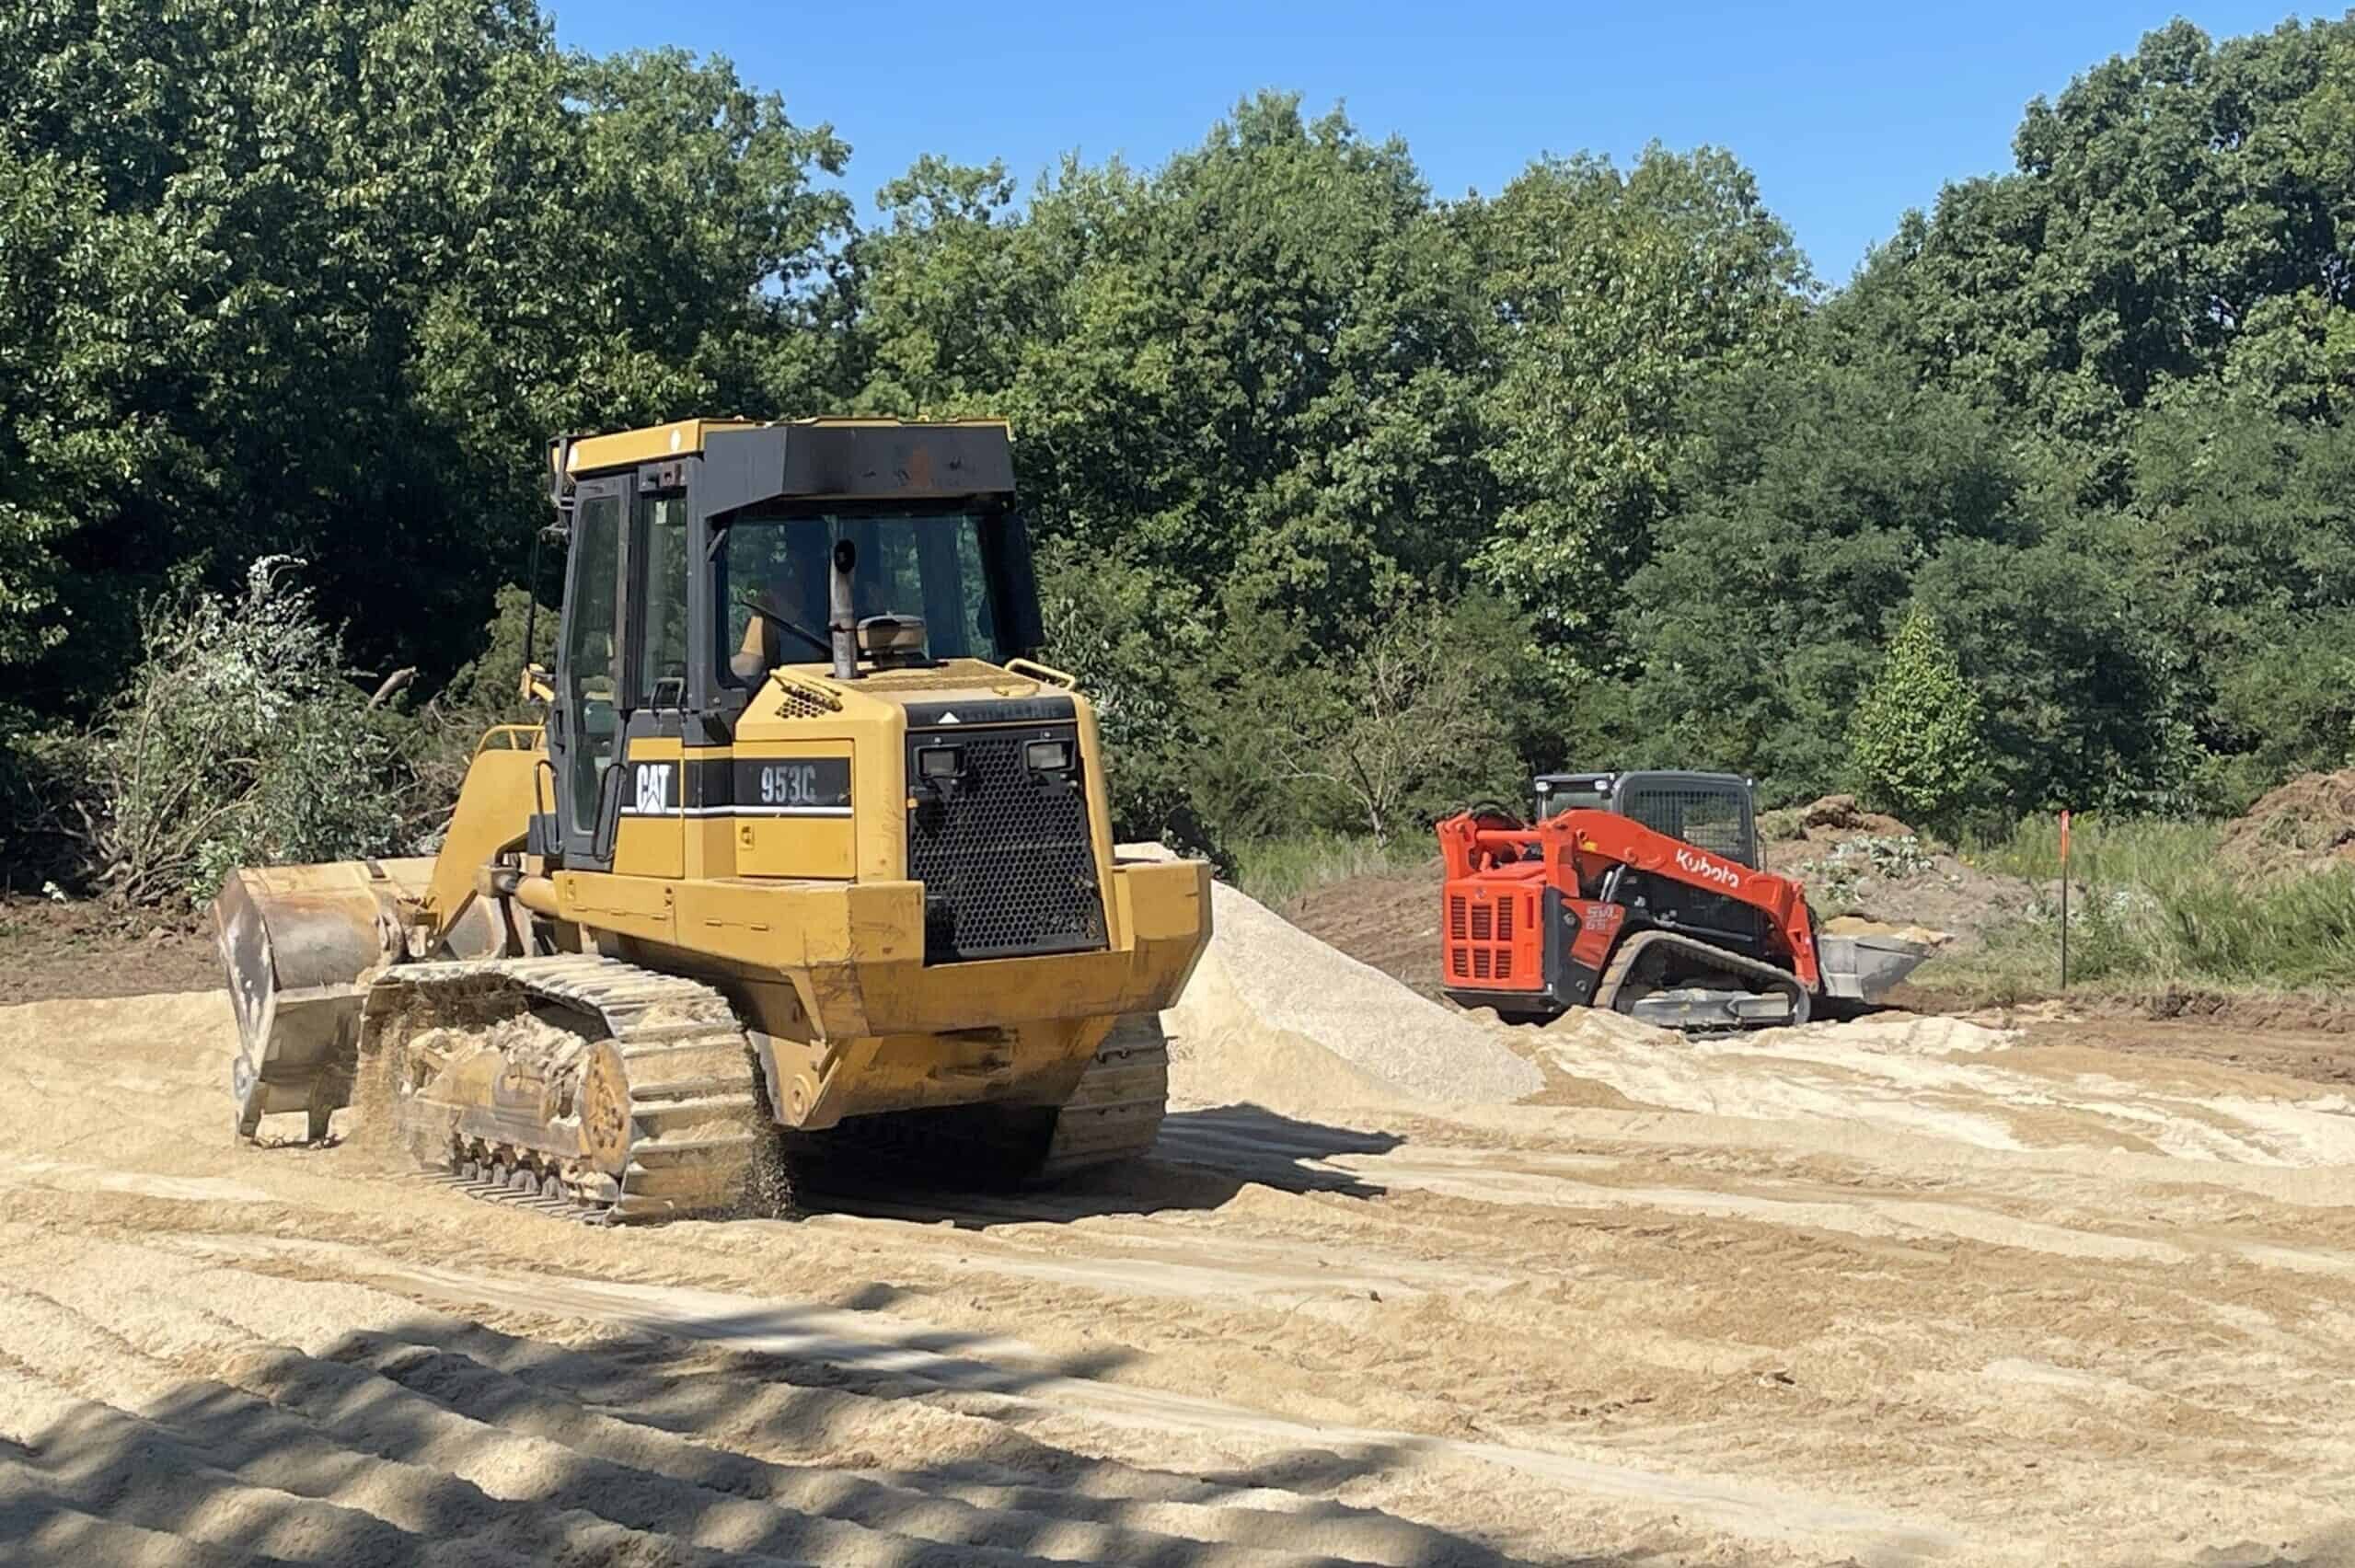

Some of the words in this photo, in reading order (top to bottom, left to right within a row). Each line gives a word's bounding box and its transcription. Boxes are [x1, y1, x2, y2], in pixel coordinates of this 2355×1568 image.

[636, 764, 672, 813] CAT
[761, 766, 816, 803] 953C
[1676, 847, 1739, 889] Kubota
